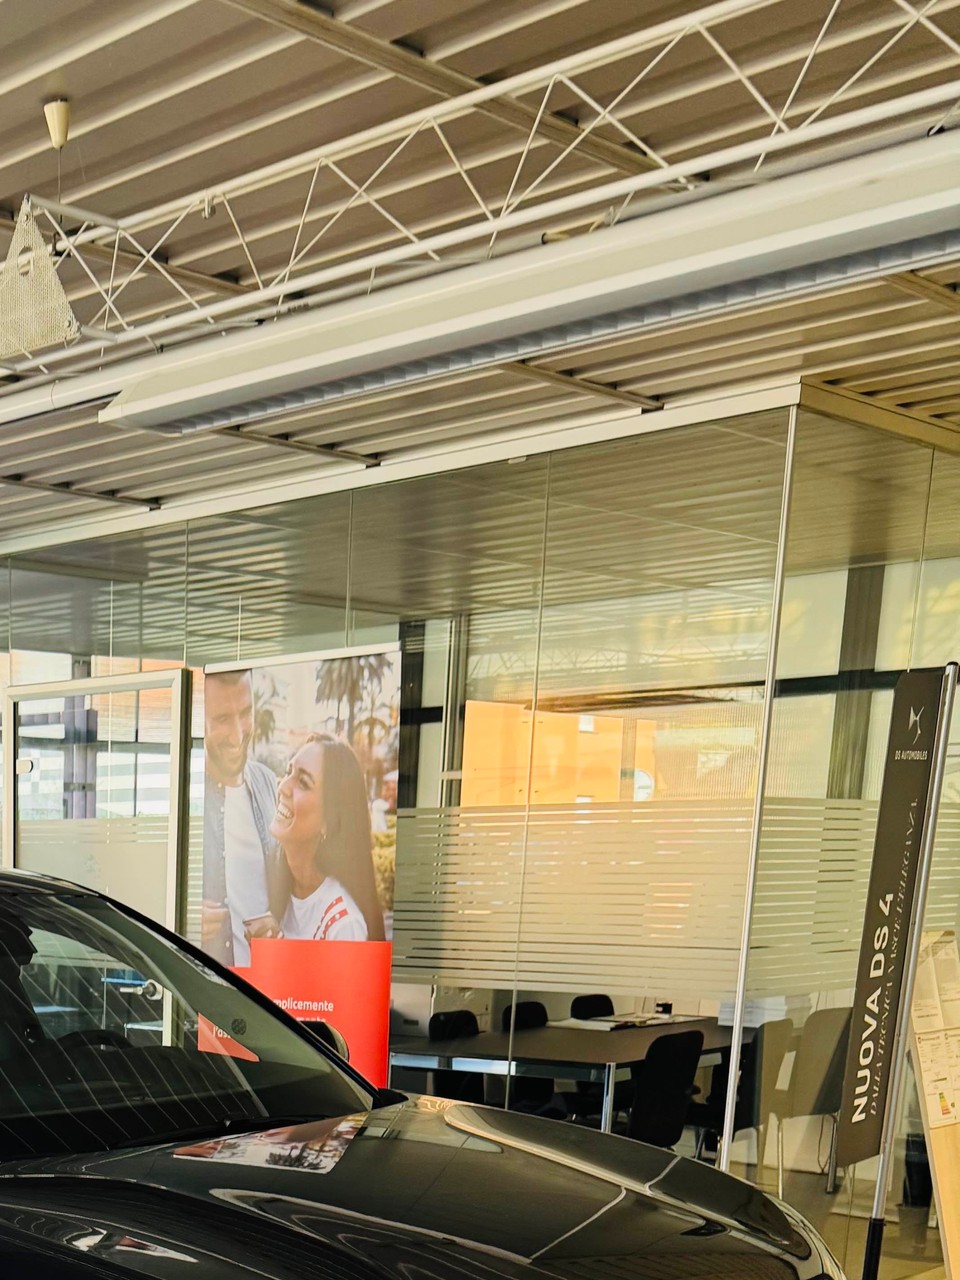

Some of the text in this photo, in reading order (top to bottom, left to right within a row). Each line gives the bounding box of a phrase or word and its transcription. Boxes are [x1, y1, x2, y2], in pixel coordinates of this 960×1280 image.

[901, 750, 928, 760] AUTOMOBILES
[272, 997, 334, 1012] mplicemente
[851, 893, 894, 1123] NUOVA DS 4
